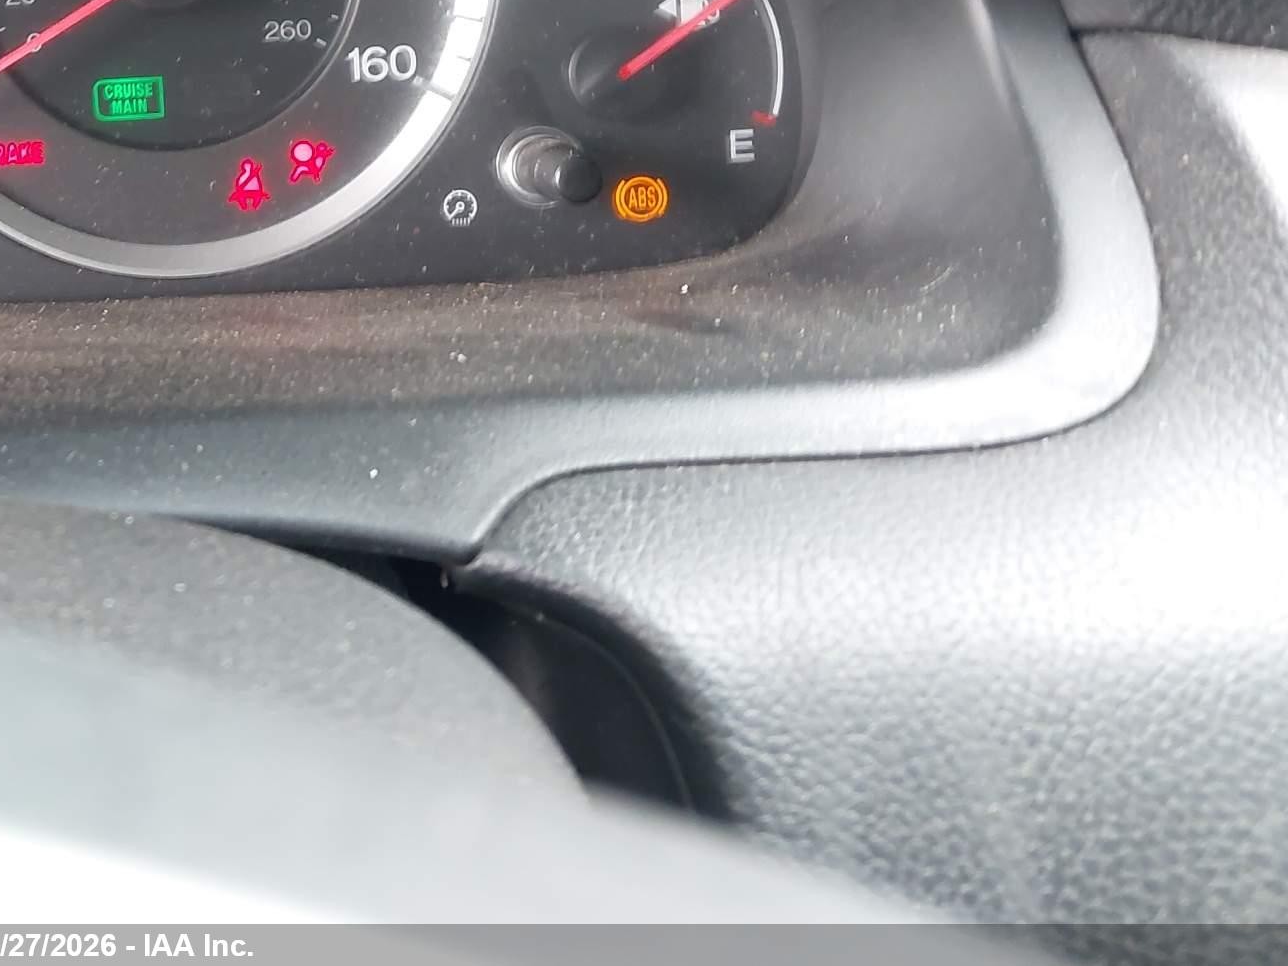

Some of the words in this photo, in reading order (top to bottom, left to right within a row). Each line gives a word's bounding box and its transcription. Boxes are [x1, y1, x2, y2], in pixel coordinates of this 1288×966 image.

[264, 20, 312, 42] 260
[347, 45, 416, 82] 160
[103, 82, 153, 99] CRUISE
[111, 98, 148, 114] MAIN
[728, 128, 755, 163] E
[628, 186, 657, 209] ABS
